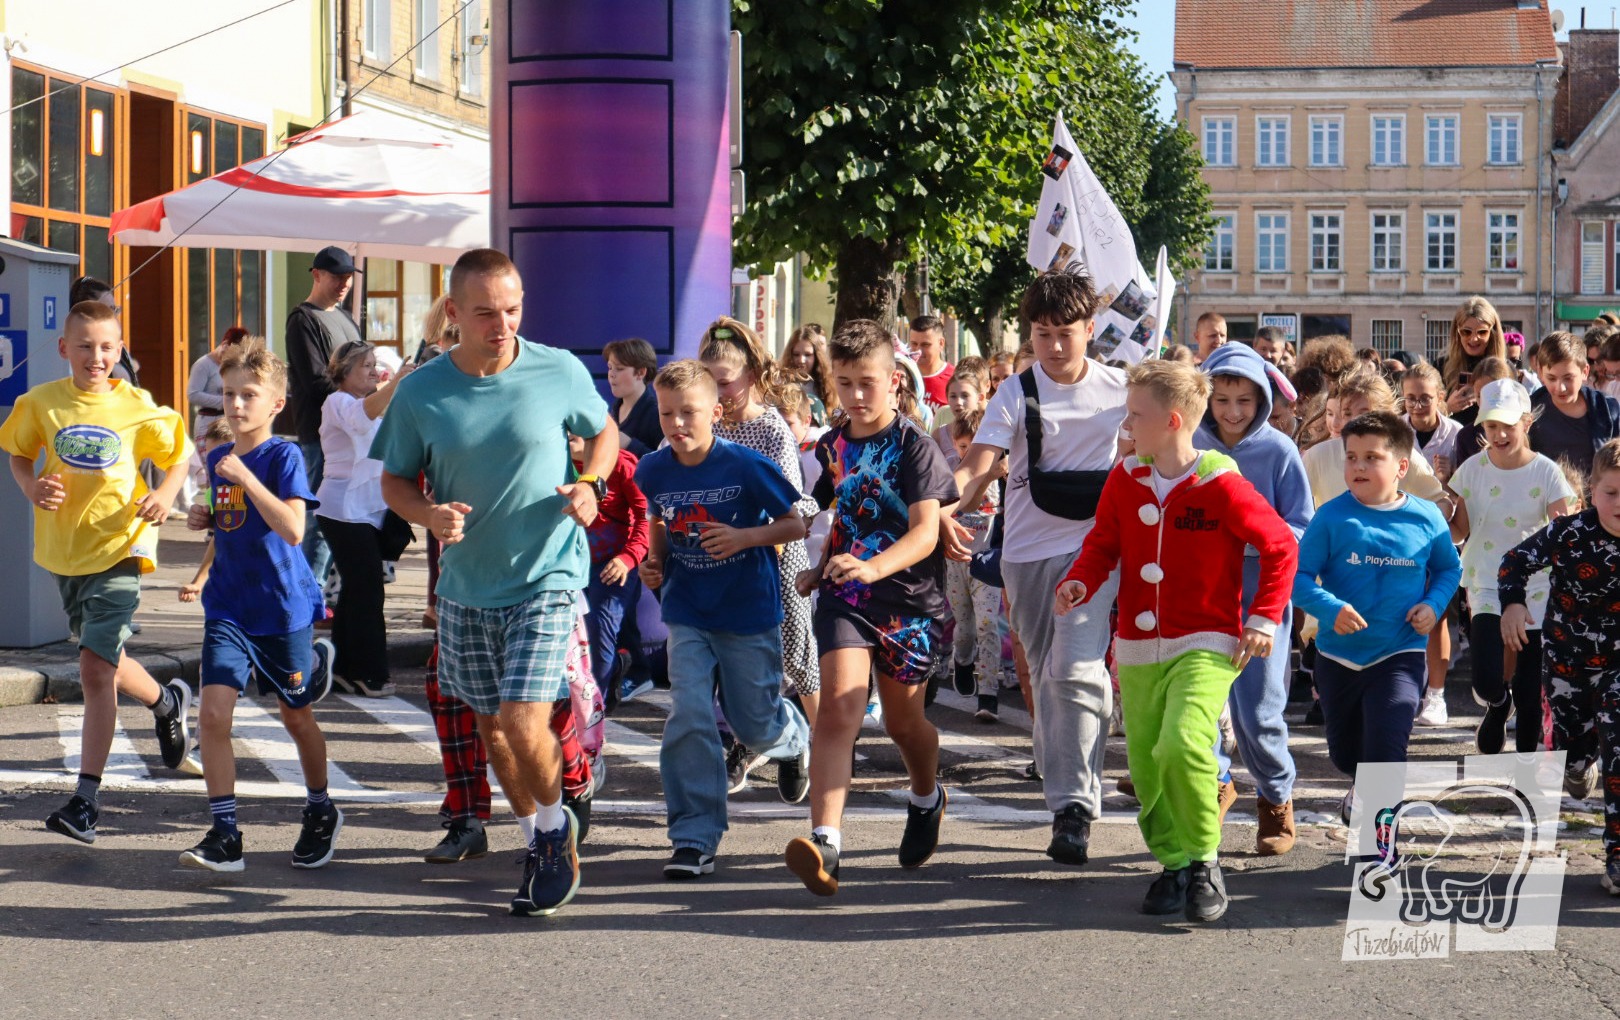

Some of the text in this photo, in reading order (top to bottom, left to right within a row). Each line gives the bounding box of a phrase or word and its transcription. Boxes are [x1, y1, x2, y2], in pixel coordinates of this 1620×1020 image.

[46, 300, 54, 325] P
[654, 486, 741, 507] SPEED
[1186, 507, 1205, 518] THE
[1365, 555, 1416, 567] PlayStation
